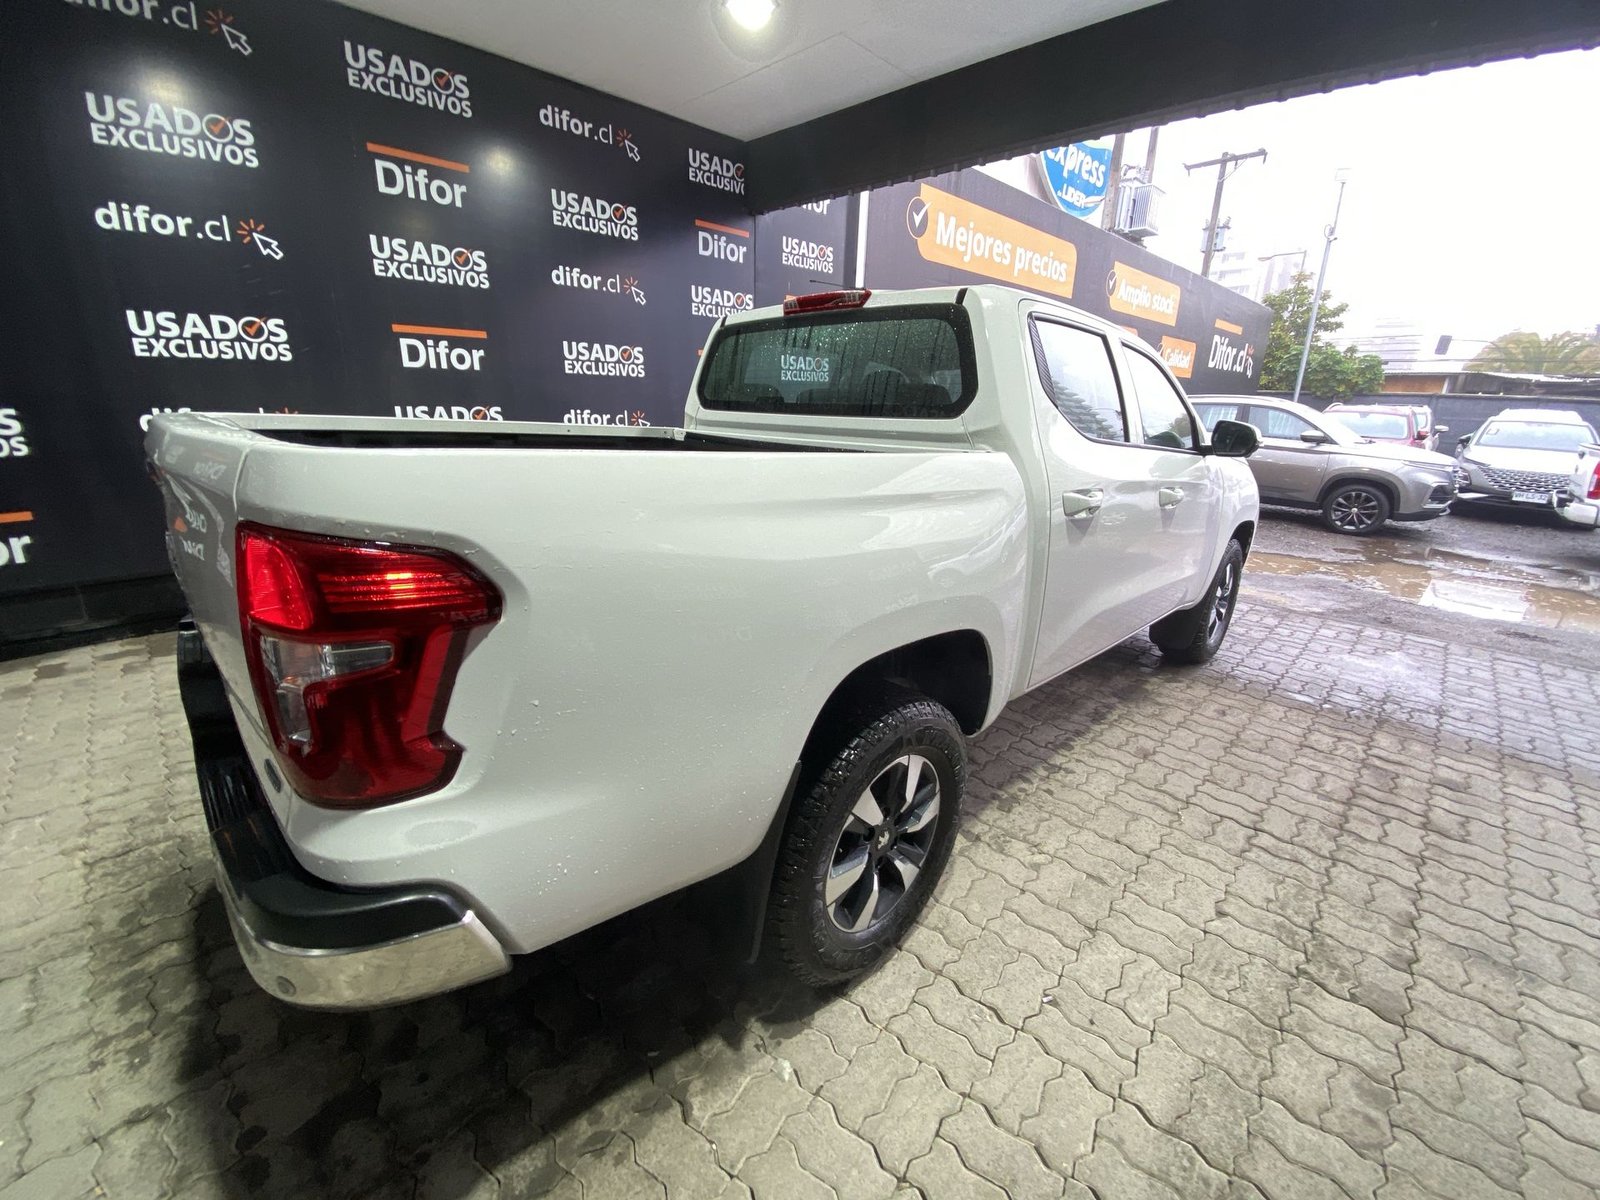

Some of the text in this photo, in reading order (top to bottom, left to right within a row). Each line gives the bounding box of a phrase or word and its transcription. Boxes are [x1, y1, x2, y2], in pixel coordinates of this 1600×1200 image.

[64, 0, 198, 30] or.cl
[344, 40, 470, 99] USADOS
[347, 68, 473, 118] EXCLUSIVOS
[85, 92, 255, 146] USADOS
[539, 105, 613, 145] difor.cl
[90, 123, 259, 167] EXCLUSIVOS
[688, 147, 745, 182] USADO
[374, 159, 467, 207] Difor
[688, 167, 745, 196] EXCLUSIV
[95, 201, 232, 242] difor.cl
[551, 188, 637, 225] USADOS
[552, 211, 639, 241] EXCLUSIVOS
[369, 234, 488, 273] USADOS
[698, 231, 747, 263] Difor
[782, 235, 834, 262] USADOS
[782, 252, 834, 274] EXCLUSIVOS
[935, 211, 1068, 283] Mejores precios
[372, 259, 490, 289] EXCLUSIVOS
[551, 266, 621, 293] difor.cl
[691, 285, 754, 310] USADOS
[1116, 278, 1176, 315] Amplio stock
[126, 310, 288, 343] USADOS
[131, 337, 293, 362] EXCLUSIVOS
[399, 338, 485, 371] Difor
[562, 341, 644, 364] USADOS
[780, 354, 829, 371] USADOS
[1165, 346, 1192, 368] Calidad
[1207, 334, 1248, 373] Difor.cl
[564, 360, 646, 377] EXCLUSIVOS
[781, 370, 829, 382] EXCLUSIVOS
